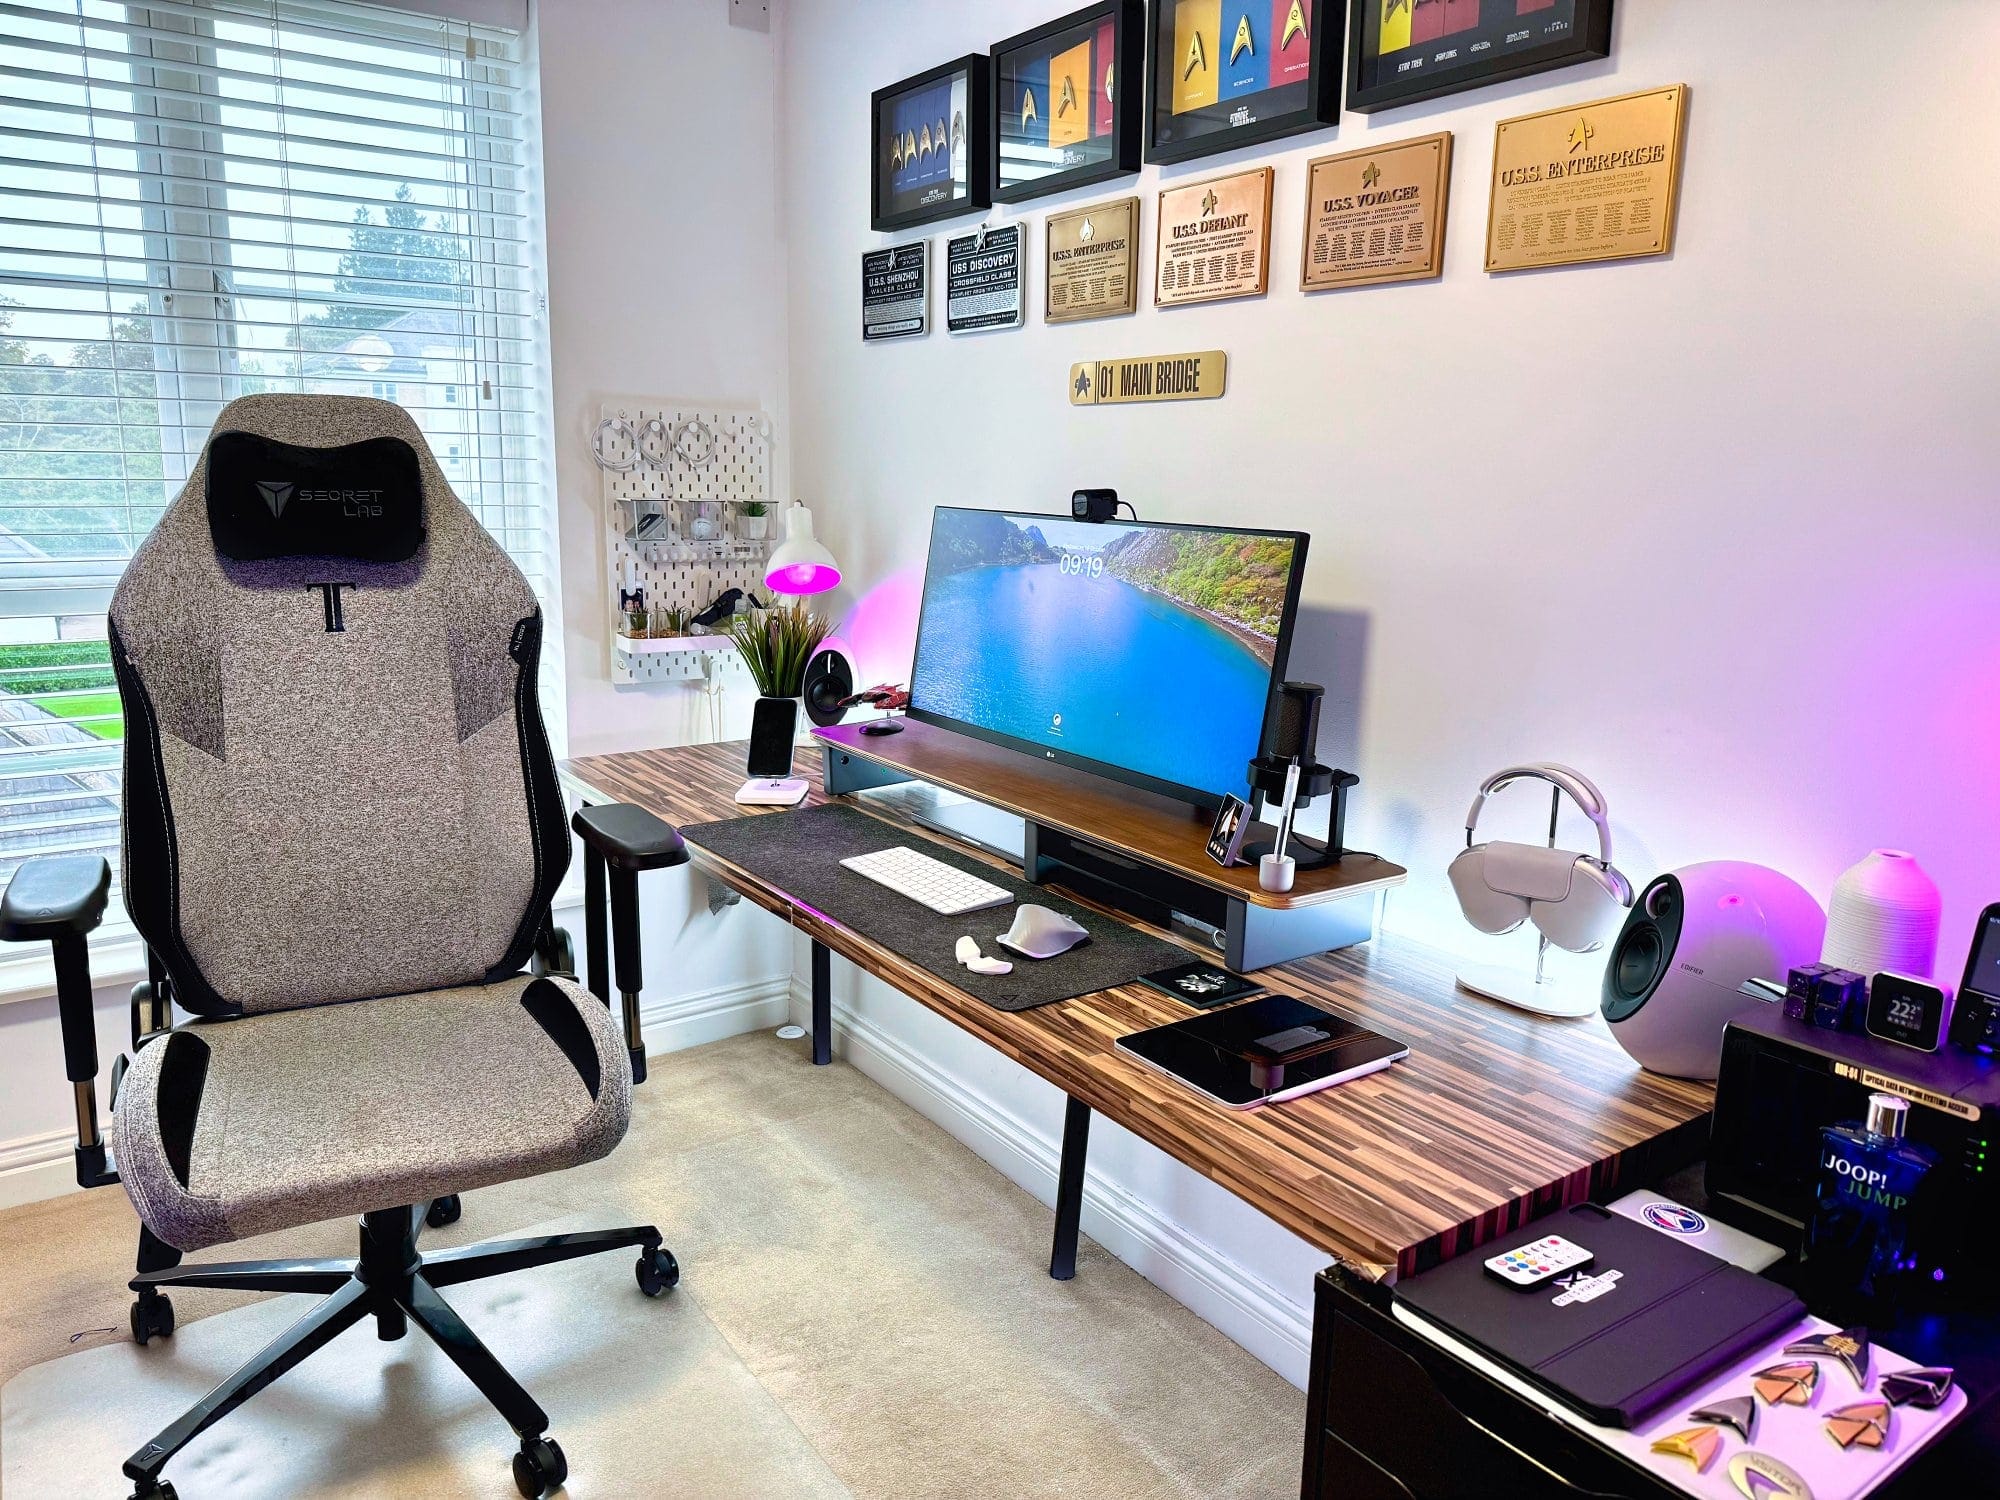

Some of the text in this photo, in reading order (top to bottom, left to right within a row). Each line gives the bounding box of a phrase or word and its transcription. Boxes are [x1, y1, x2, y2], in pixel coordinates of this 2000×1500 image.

[1500, 143, 1666, 188] U.S.S. ENTERPRISE
[1323, 186, 1420, 214] U.S.S. VOYAGER
[1172, 212, 1249, 240] U.S.S. DEFIANT
[1073, 238, 1126, 258] ENTERPRISE
[952, 252, 1015, 275] USS DISCOVERY
[870, 281, 917, 295] WALKER CLASS
[886, 269, 920, 285] SHENZHOU
[953, 271, 1012, 288] CROSSFIELD CLASS
[1100, 358, 1201, 398] 01 MAIN BRIDGE
[299, 490, 384, 504] SECRET
[343, 505, 384, 518] LAB
[1060, 553, 1103, 579] 09:19
[1680, 962, 1704, 975] EDIFIER
[1865, 1074, 1886, 1089] OPTICAL
[1885, 1080, 1899, 1092] DATA
[1898, 1083, 1923, 1100] NETWORK
[1825, 1154, 1887, 1190] JOOP!
[1844, 1180, 1907, 1210] JUMP
